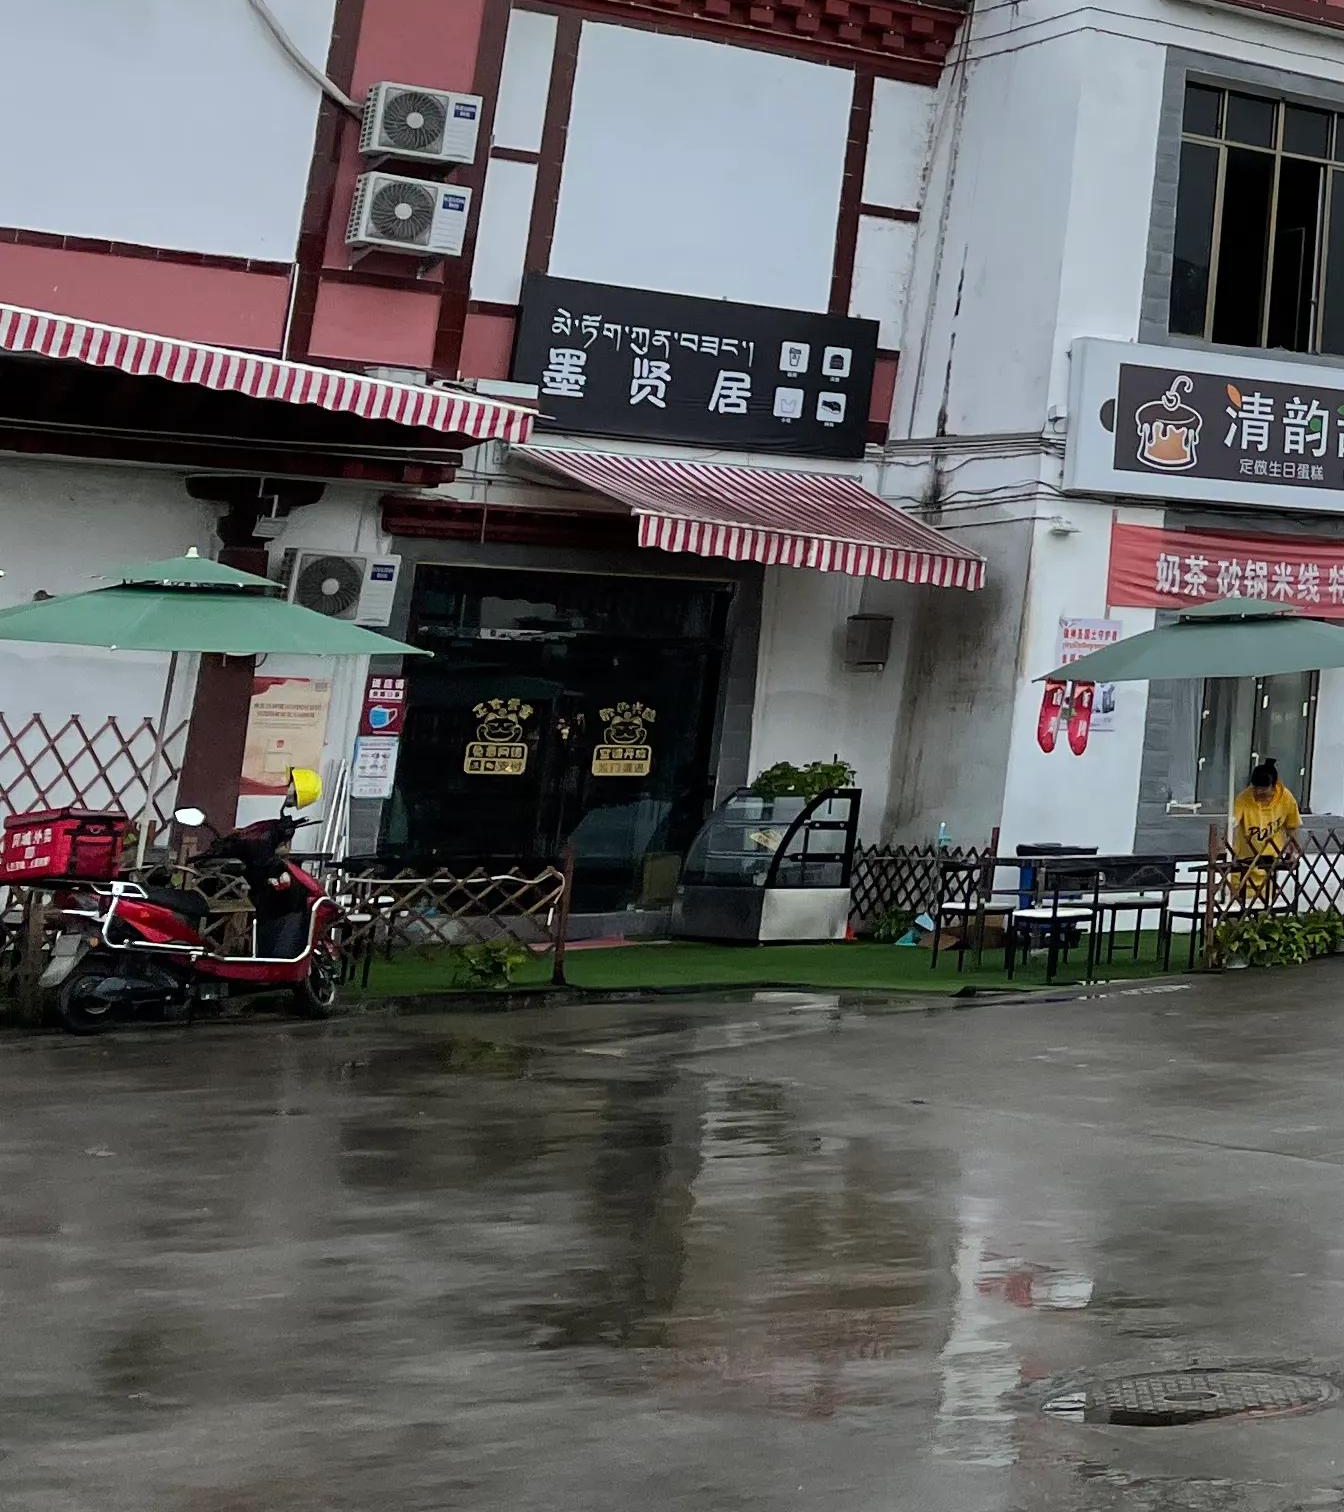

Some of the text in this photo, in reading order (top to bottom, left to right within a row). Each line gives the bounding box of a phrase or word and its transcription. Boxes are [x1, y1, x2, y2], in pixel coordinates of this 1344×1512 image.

[541, 347, 752, 414] 墨贤居
[1239, 458, 1325, 481] 定做生日蛋糕
[1155, 552, 1209, 596] 奶茶
[1216, 558, 1320, 603] 砂锅米线
